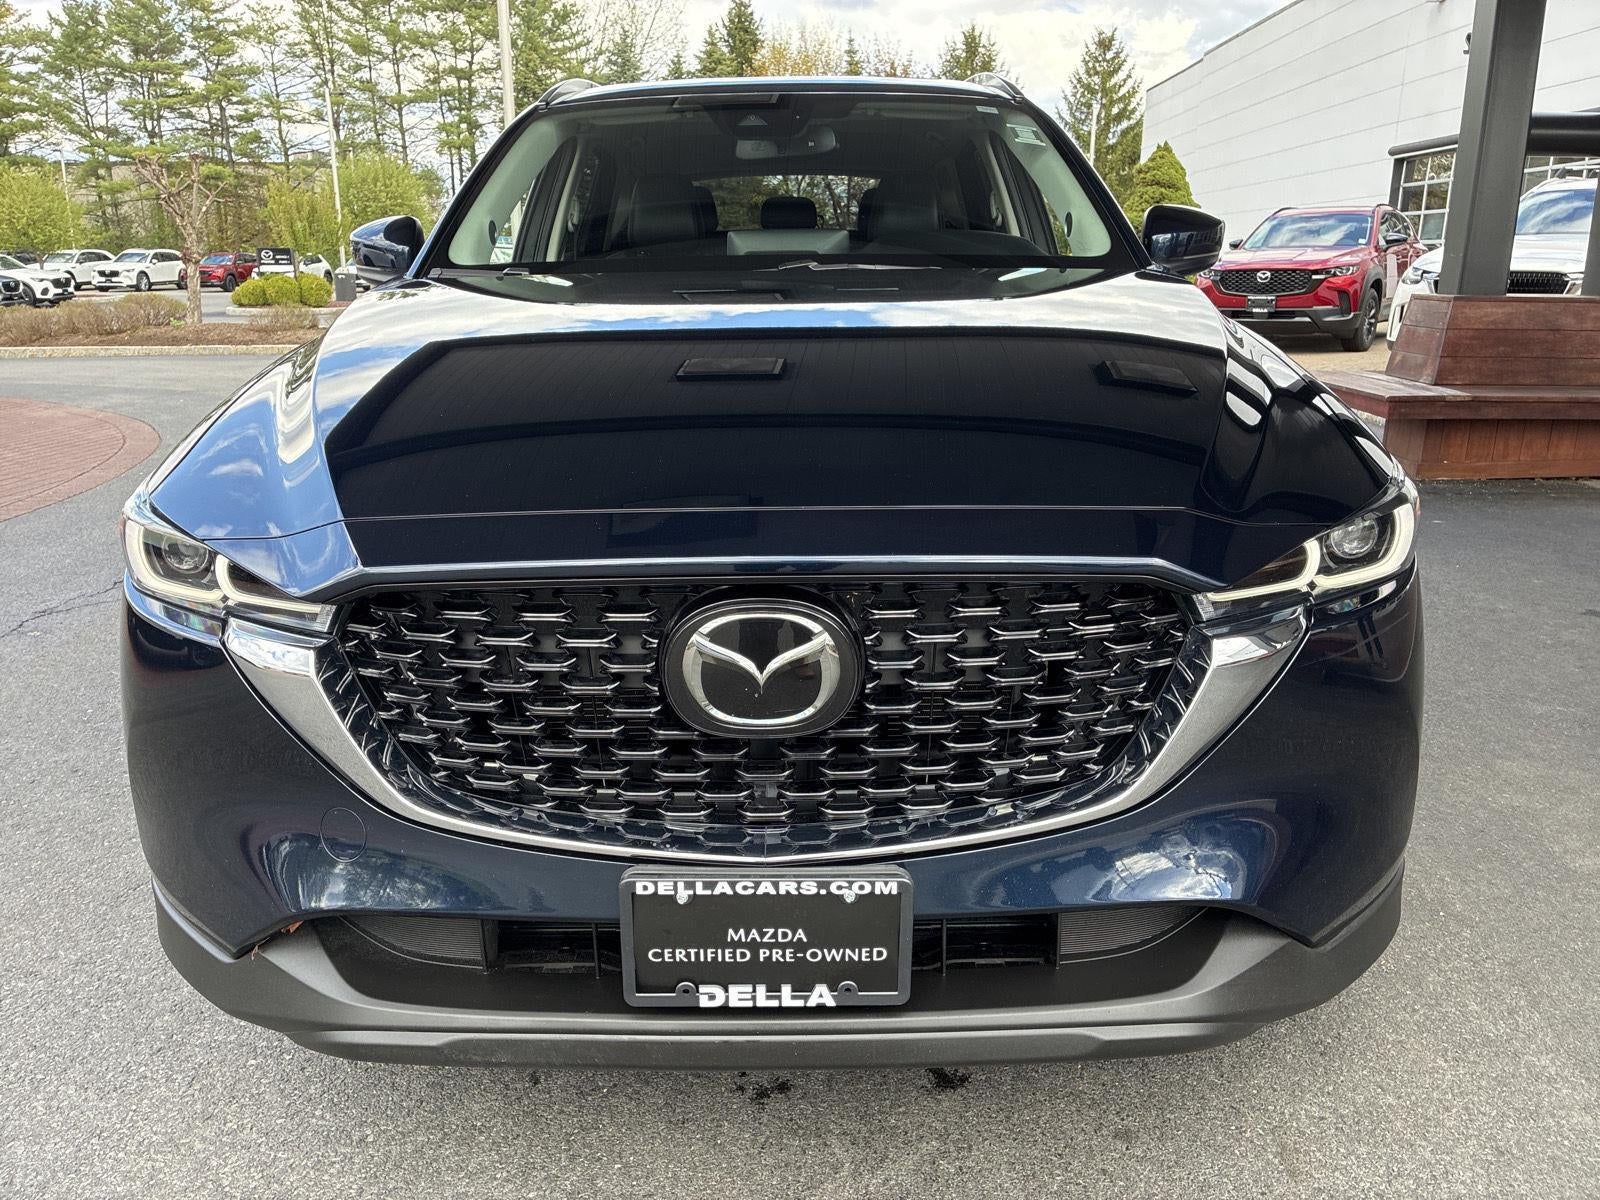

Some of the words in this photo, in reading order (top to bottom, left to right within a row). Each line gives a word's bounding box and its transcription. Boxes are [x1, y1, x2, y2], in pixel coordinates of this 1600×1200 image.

[635, 881, 898, 895] DELLACARS.COM
[727, 928, 808, 943] MAZDA
[647, 948, 751, 963] CERTIFIED
[759, 947, 888, 962] PRE-OWNED
[698, 984, 837, 1008] DELLA
